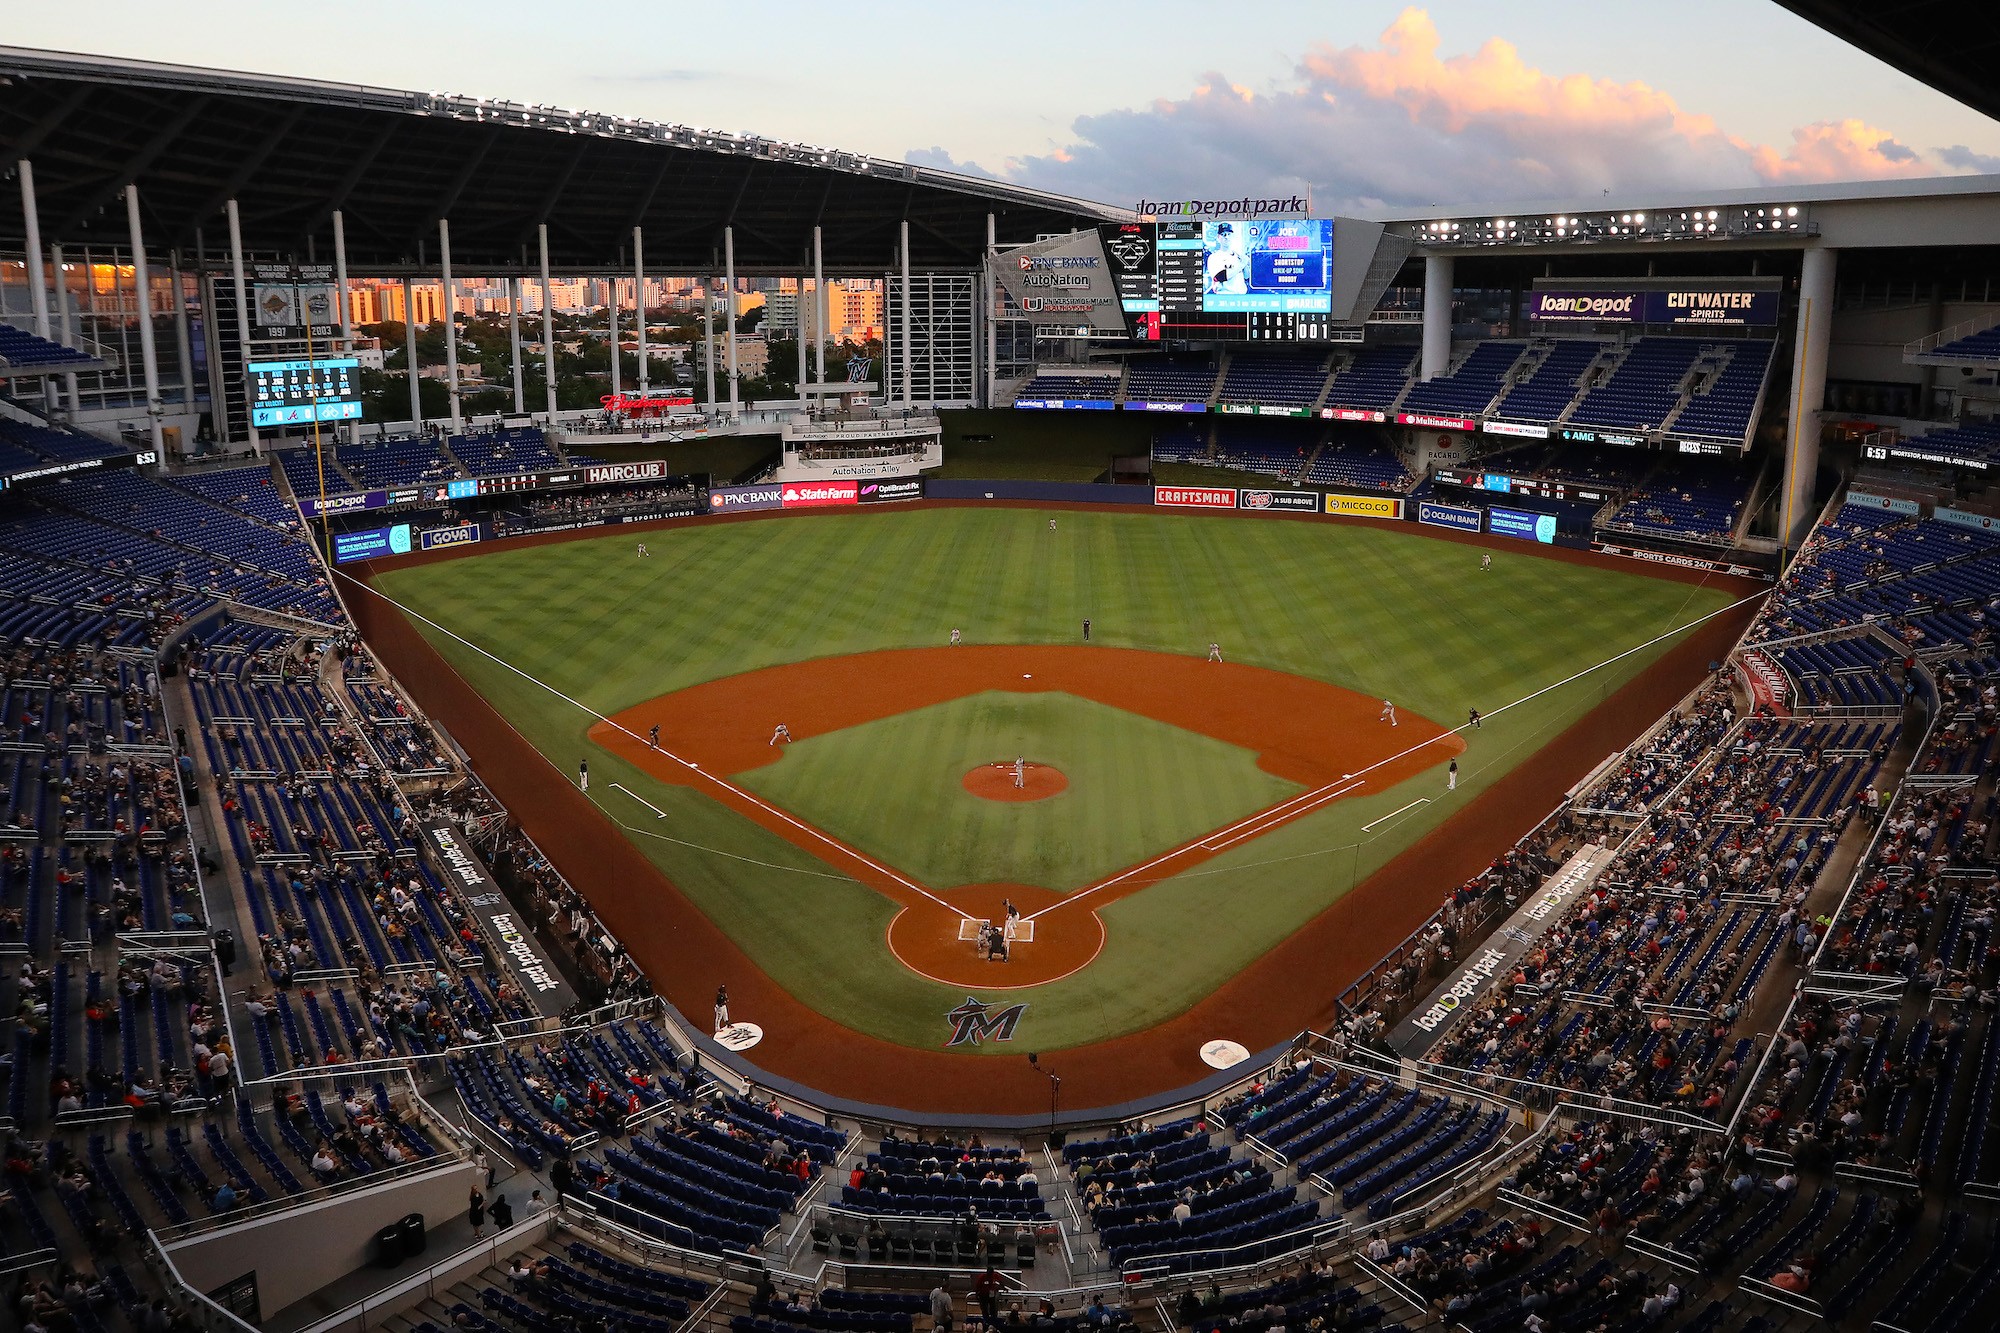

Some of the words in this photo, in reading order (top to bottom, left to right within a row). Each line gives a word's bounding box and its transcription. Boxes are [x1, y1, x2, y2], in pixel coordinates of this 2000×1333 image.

[1140, 198, 1249, 218] loanDepot
[1254, 196, 1302, 218] park
[1278, 228, 1298, 236] JOEY
[1022, 274, 1088, 286] AutoNation
[1540, 295, 1632, 315] loanDepot
[1667, 293, 1752, 308] CUTWATER
[1691, 310, 1725, 318] SPIRITS
[268, 327, 286, 337] 1997
[311, 326, 332, 336] 2003
[1322, 324, 1327, 338] 1
[1146, 402, 1185, 411] loanDepot
[1415, 416, 1464, 428] Multinational
[1572, 432, 1594, 441] AMG
[1679, 441, 1700, 453] RECESS
[136, 452, 155, 465] 6:53
[1867, 447, 1886, 459] 6:53
[1891, 449, 1921, 459] SHORTSTOP,
[1922, 454, 1944, 462] NUMBER
[590, 464, 661, 482] HAIRCLUB
[832, 467, 876, 475] AutoNation
[314, 495, 366, 510] loanDepot
[1341, 501, 1388, 512] MICCO.CO
[1850, 494, 1881, 505] ESTRELLA
[1891, 501, 1917, 511] JALISCO
[634, 513, 662, 521] SPORTS
[1431, 511, 1456, 522] OCEAN
[1457, 515, 1478, 526] BANK
[1950, 512, 1982, 524] ESTRELLA
[433, 529, 469, 544] GOYA
[1632, 551, 1664, 561] SPORTS
[1665, 556, 1693, 566] CARDS
[1694, 560, 1713, 570] 24/7
[1763, 574, 1774, 582] 335
[452, 863, 486, 886] park
[1570, 859, 1594, 881] park
[520, 964, 560, 993] park
[1412, 969, 1484, 1032] loanDepot
[1476, 948, 1506, 978] park
